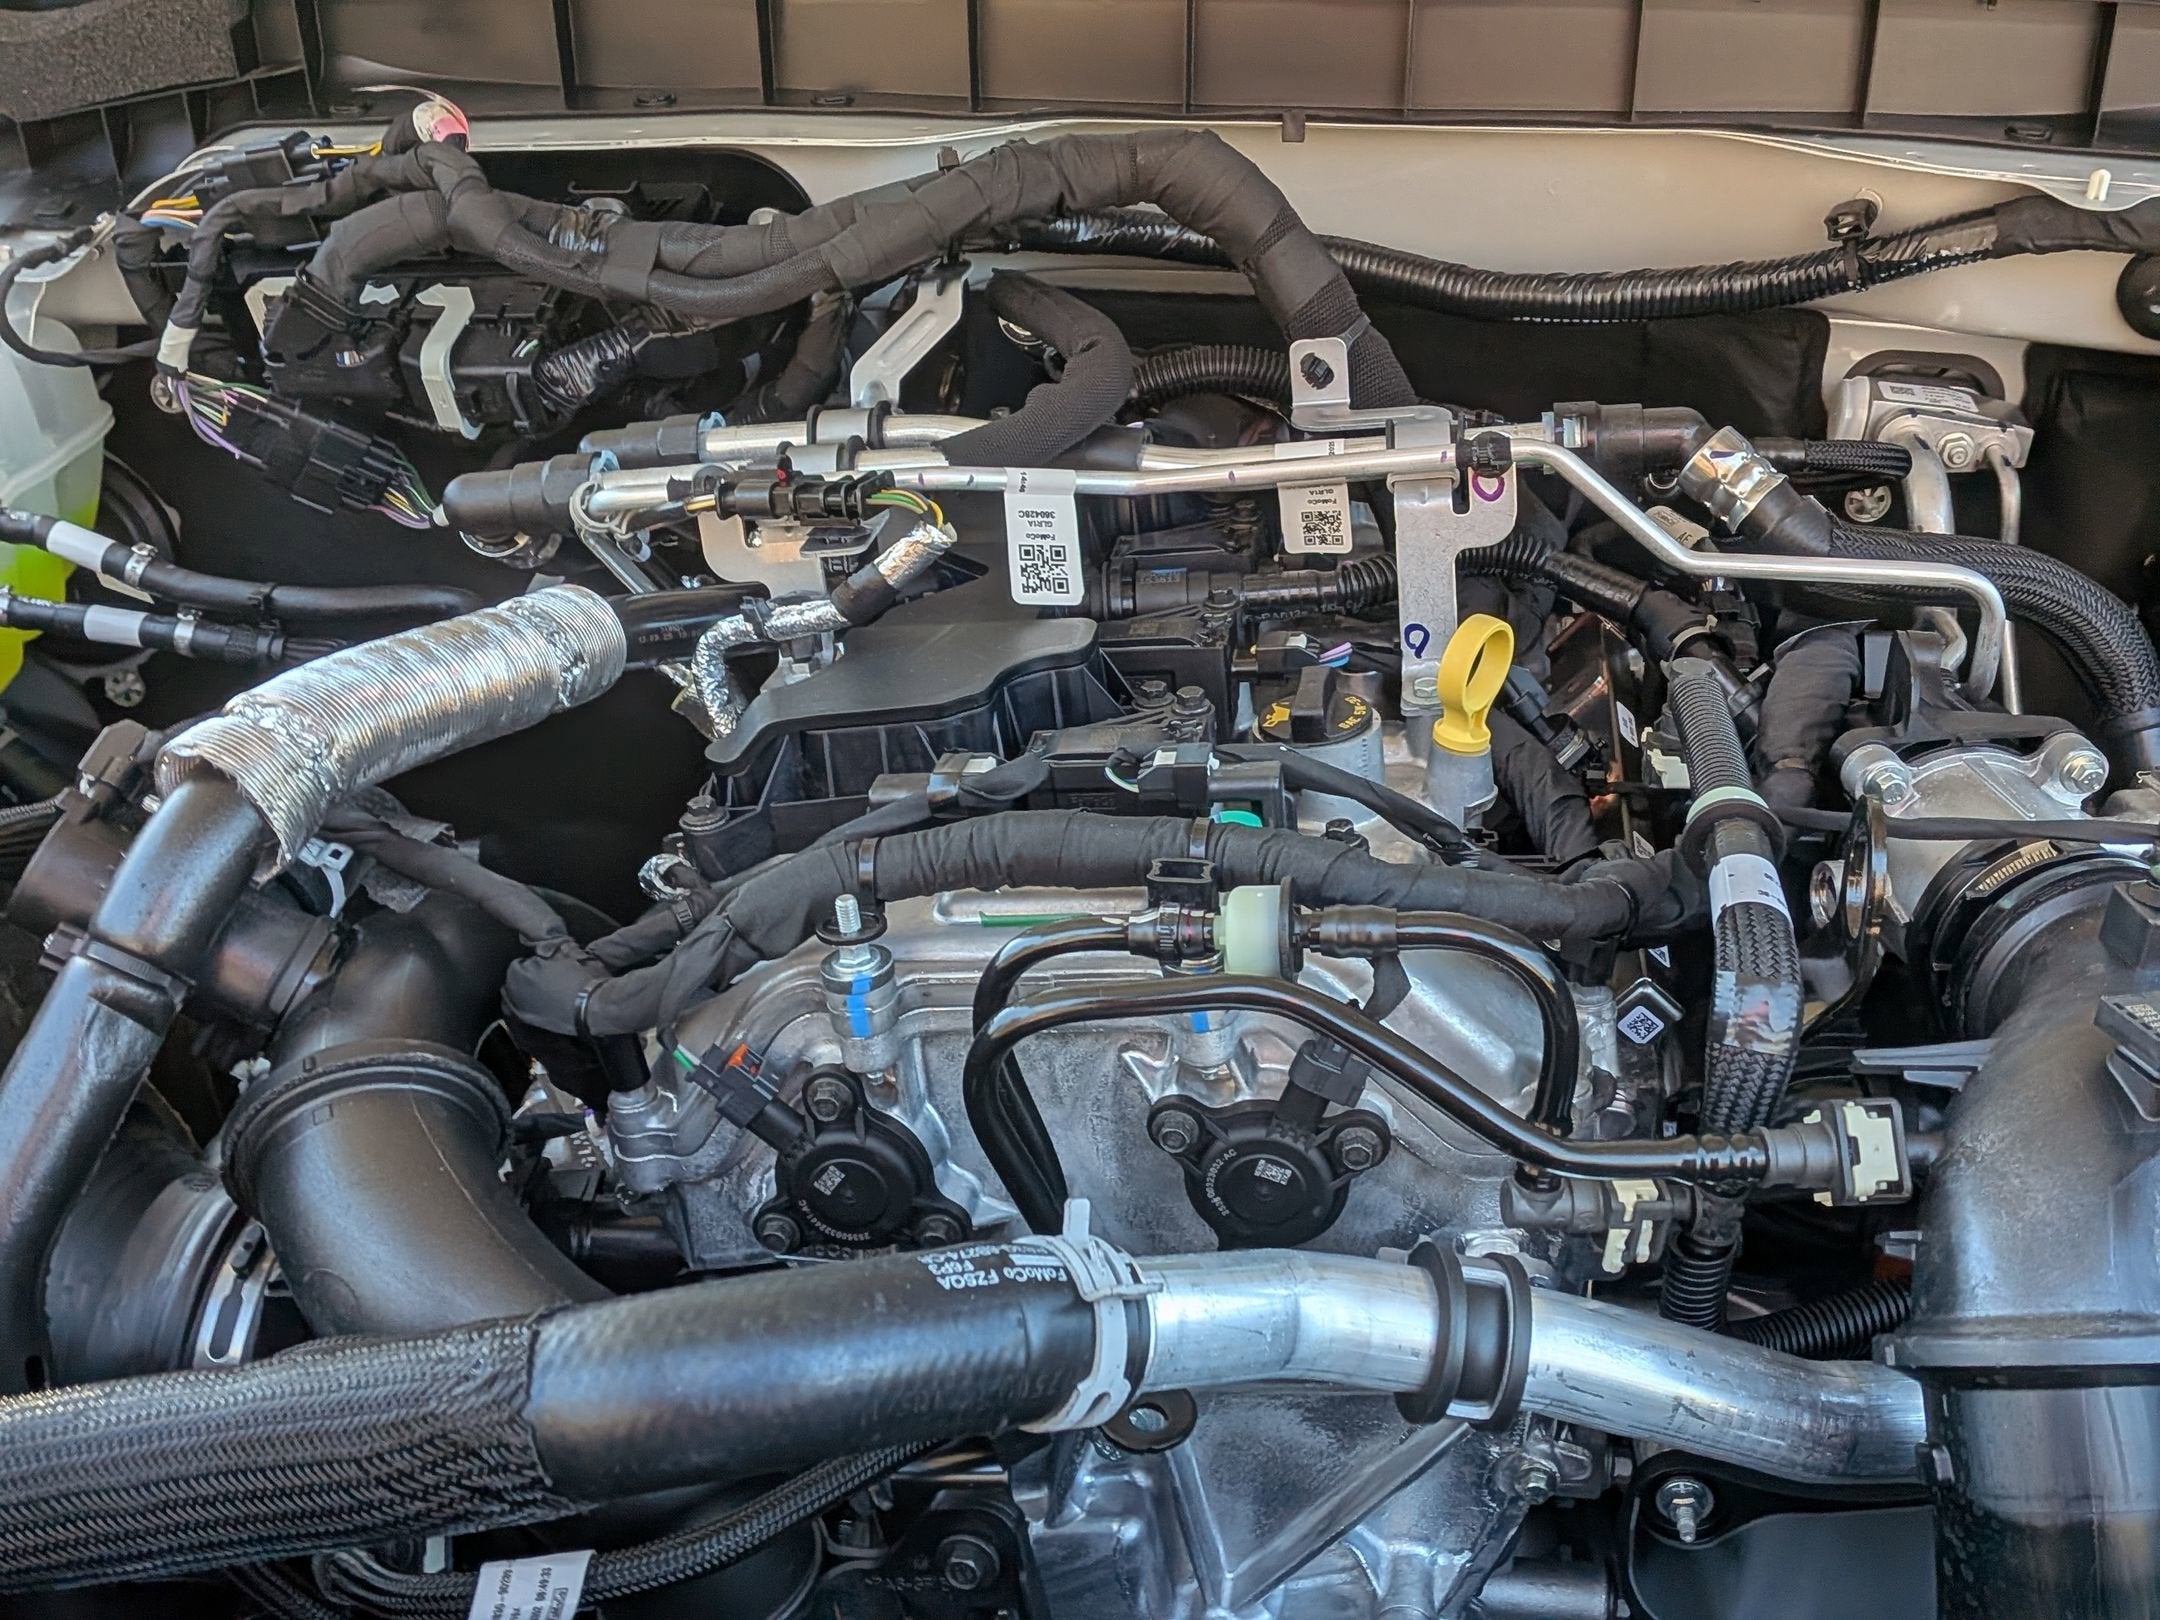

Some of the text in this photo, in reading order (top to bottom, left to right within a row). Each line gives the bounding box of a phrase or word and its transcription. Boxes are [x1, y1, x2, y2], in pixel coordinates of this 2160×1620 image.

[1307, 497, 1337, 505] FoMoCo
[1027, 519, 1053, 528] GLR1A
[1025, 532, 1055, 541] FoMoCo
[1337, 716, 1362, 729] SAE
[1003, 1266, 1068, 1283] FoMoCo
